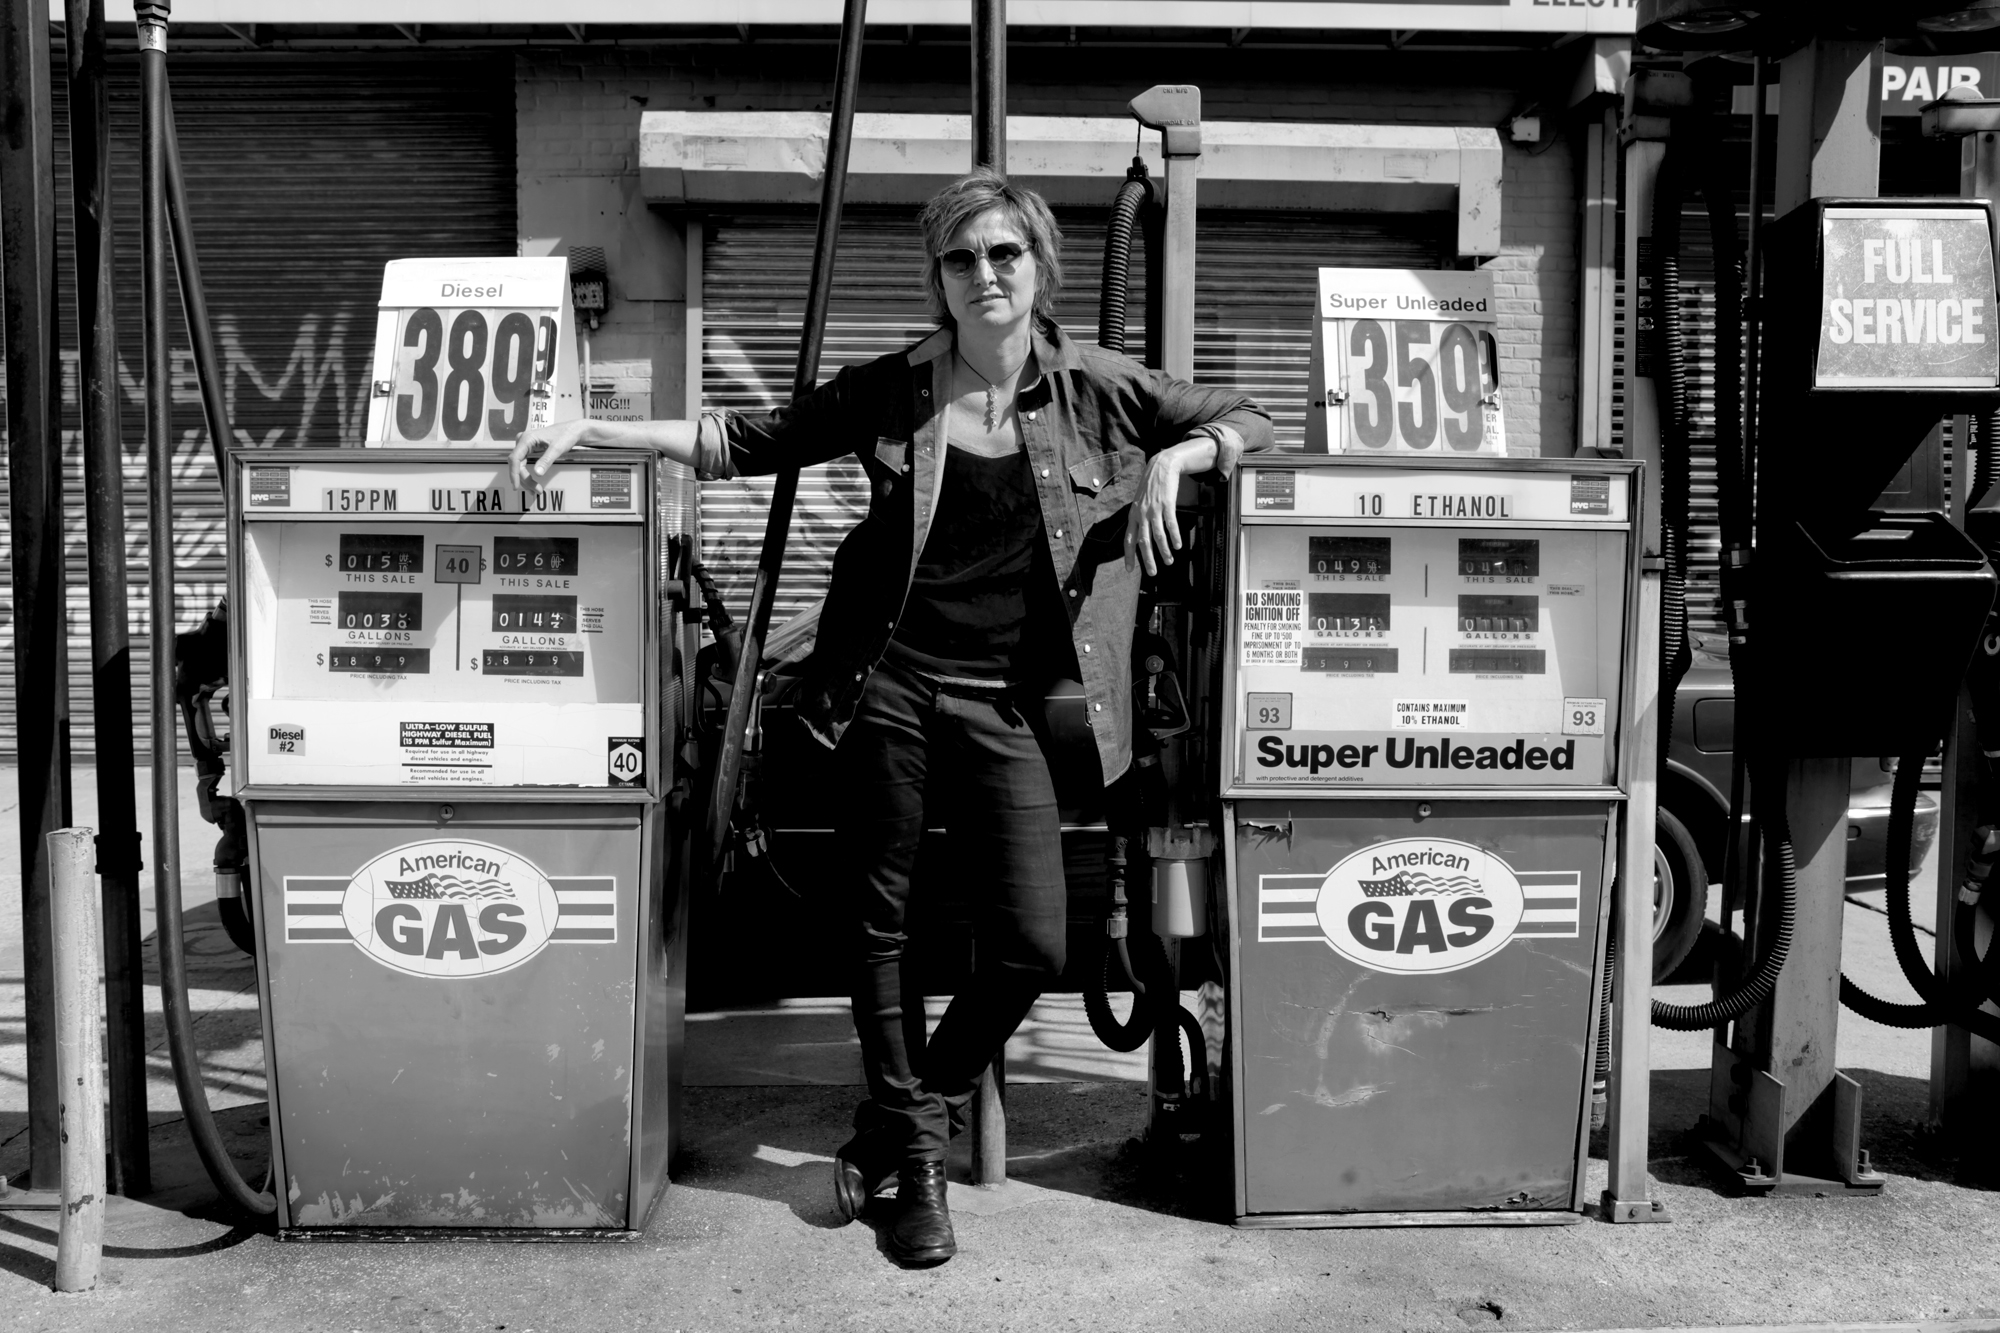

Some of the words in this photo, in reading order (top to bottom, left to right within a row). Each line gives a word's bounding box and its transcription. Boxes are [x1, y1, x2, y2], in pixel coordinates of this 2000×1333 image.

[1863, 239, 1954, 284] FULL
[441, 283, 503, 298] Diesel
[1330, 293, 1387, 311] Super
[1397, 295, 1487, 312] Unleaded
[1829, 298, 1985, 344] SERVICE
[327, 490, 397, 511] 15PPM
[432, 489, 502, 512] ULTRA
[521, 490, 564, 512] LOW
[1359, 494, 1382, 516] 10
[1413, 495, 1509, 517] ETHANOL
[325, 554, 333, 568] $
[446, 558, 469, 573] 40
[346, 574, 375, 582] THIS
[382, 575, 415, 584] SALE
[500, 578, 530, 587] THIS
[536, 579, 570, 589] SALE
[1246, 592, 1258, 606] NO
[1261, 593, 1301, 607] SMOKING
[1246, 607, 1283, 621] IGNITION
[1286, 607, 1300, 621] OFF
[1244, 623, 1266, 631] PENALTY
[1267, 623, 1278, 631] FOR
[1278, 623, 1301, 631] SMOKING
[348, 631, 411, 641] GALLONS
[502, 635, 565, 646] GALLONS
[1252, 632, 1263, 640] FINE
[1265, 632, 1272, 640] UP
[1273, 632, 1281, 640] TO
[1244, 641, 1282, 649] IMPRISONMENT
[1285, 641, 1292, 649] UP
[1294, 641, 1301, 649] TO
[317, 653, 324, 666] $
[471, 657, 478, 671] $
[1397, 703, 1430, 713] CONTAINS
[1433, 703, 1466, 713] MAXIMUM
[1259, 707, 1280, 724] 93
[1402, 715, 1418, 725] 10%
[1421, 715, 1460, 725] ETHANOL
[1572, 710, 1596, 726] 93
[270, 728, 304, 741] Diesel
[279, 741, 295, 752] #2
[454, 739, 491, 747] Maximum)
[1257, 735, 1379, 774] Super
[1386, 737, 1575, 770] Unleaded
[614, 752, 637, 773] 40
[400, 851, 501, 877] American
[1372, 848, 1470, 875] American
[375, 903, 527, 960] GAS
[1347, 896, 1495, 955] GAS
